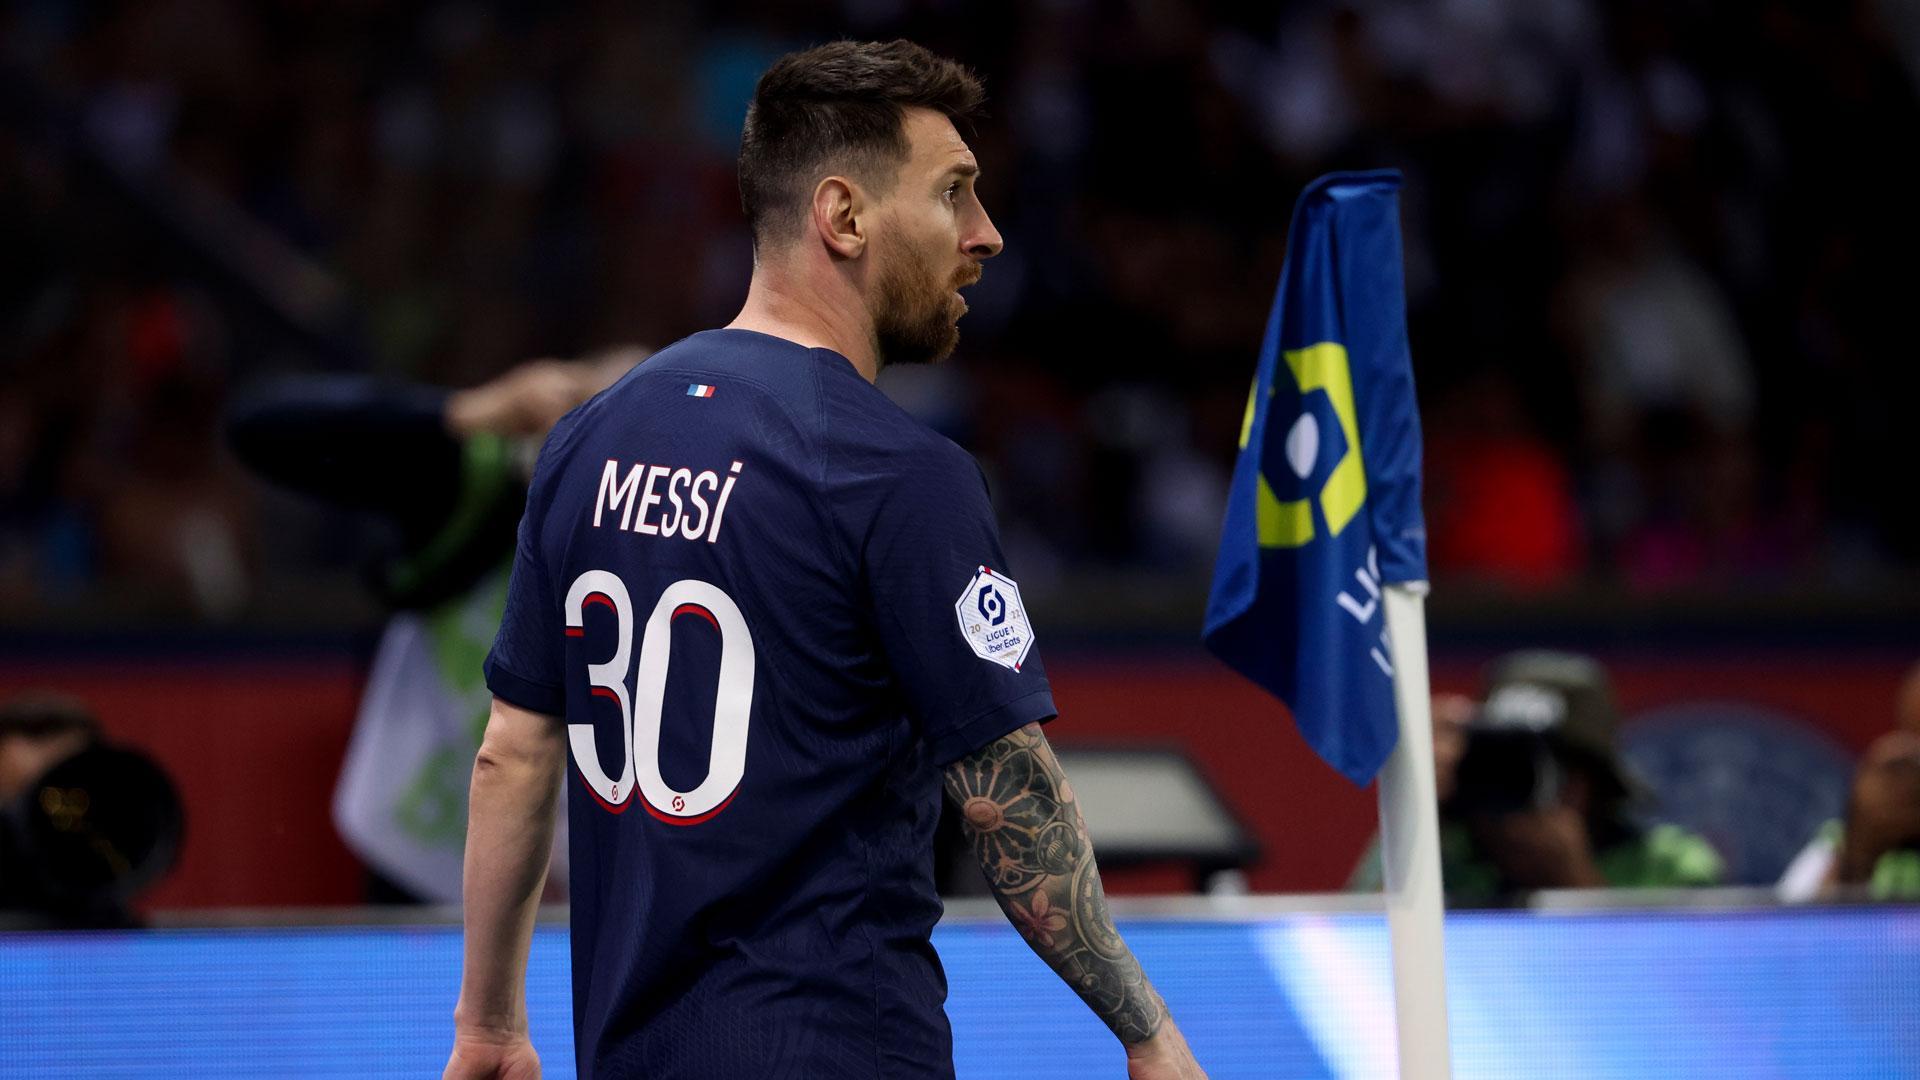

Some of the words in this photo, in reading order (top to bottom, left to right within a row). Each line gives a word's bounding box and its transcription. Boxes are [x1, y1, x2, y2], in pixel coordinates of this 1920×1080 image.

[970, 624, 981, 634] 20
[986, 627, 1009, 642] LIGUE
[1010, 625, 1015, 633] 1
[984, 643, 1003, 654] Uber
[1003, 636, 1021, 648] Eats
[565, 569, 755, 825] 30
